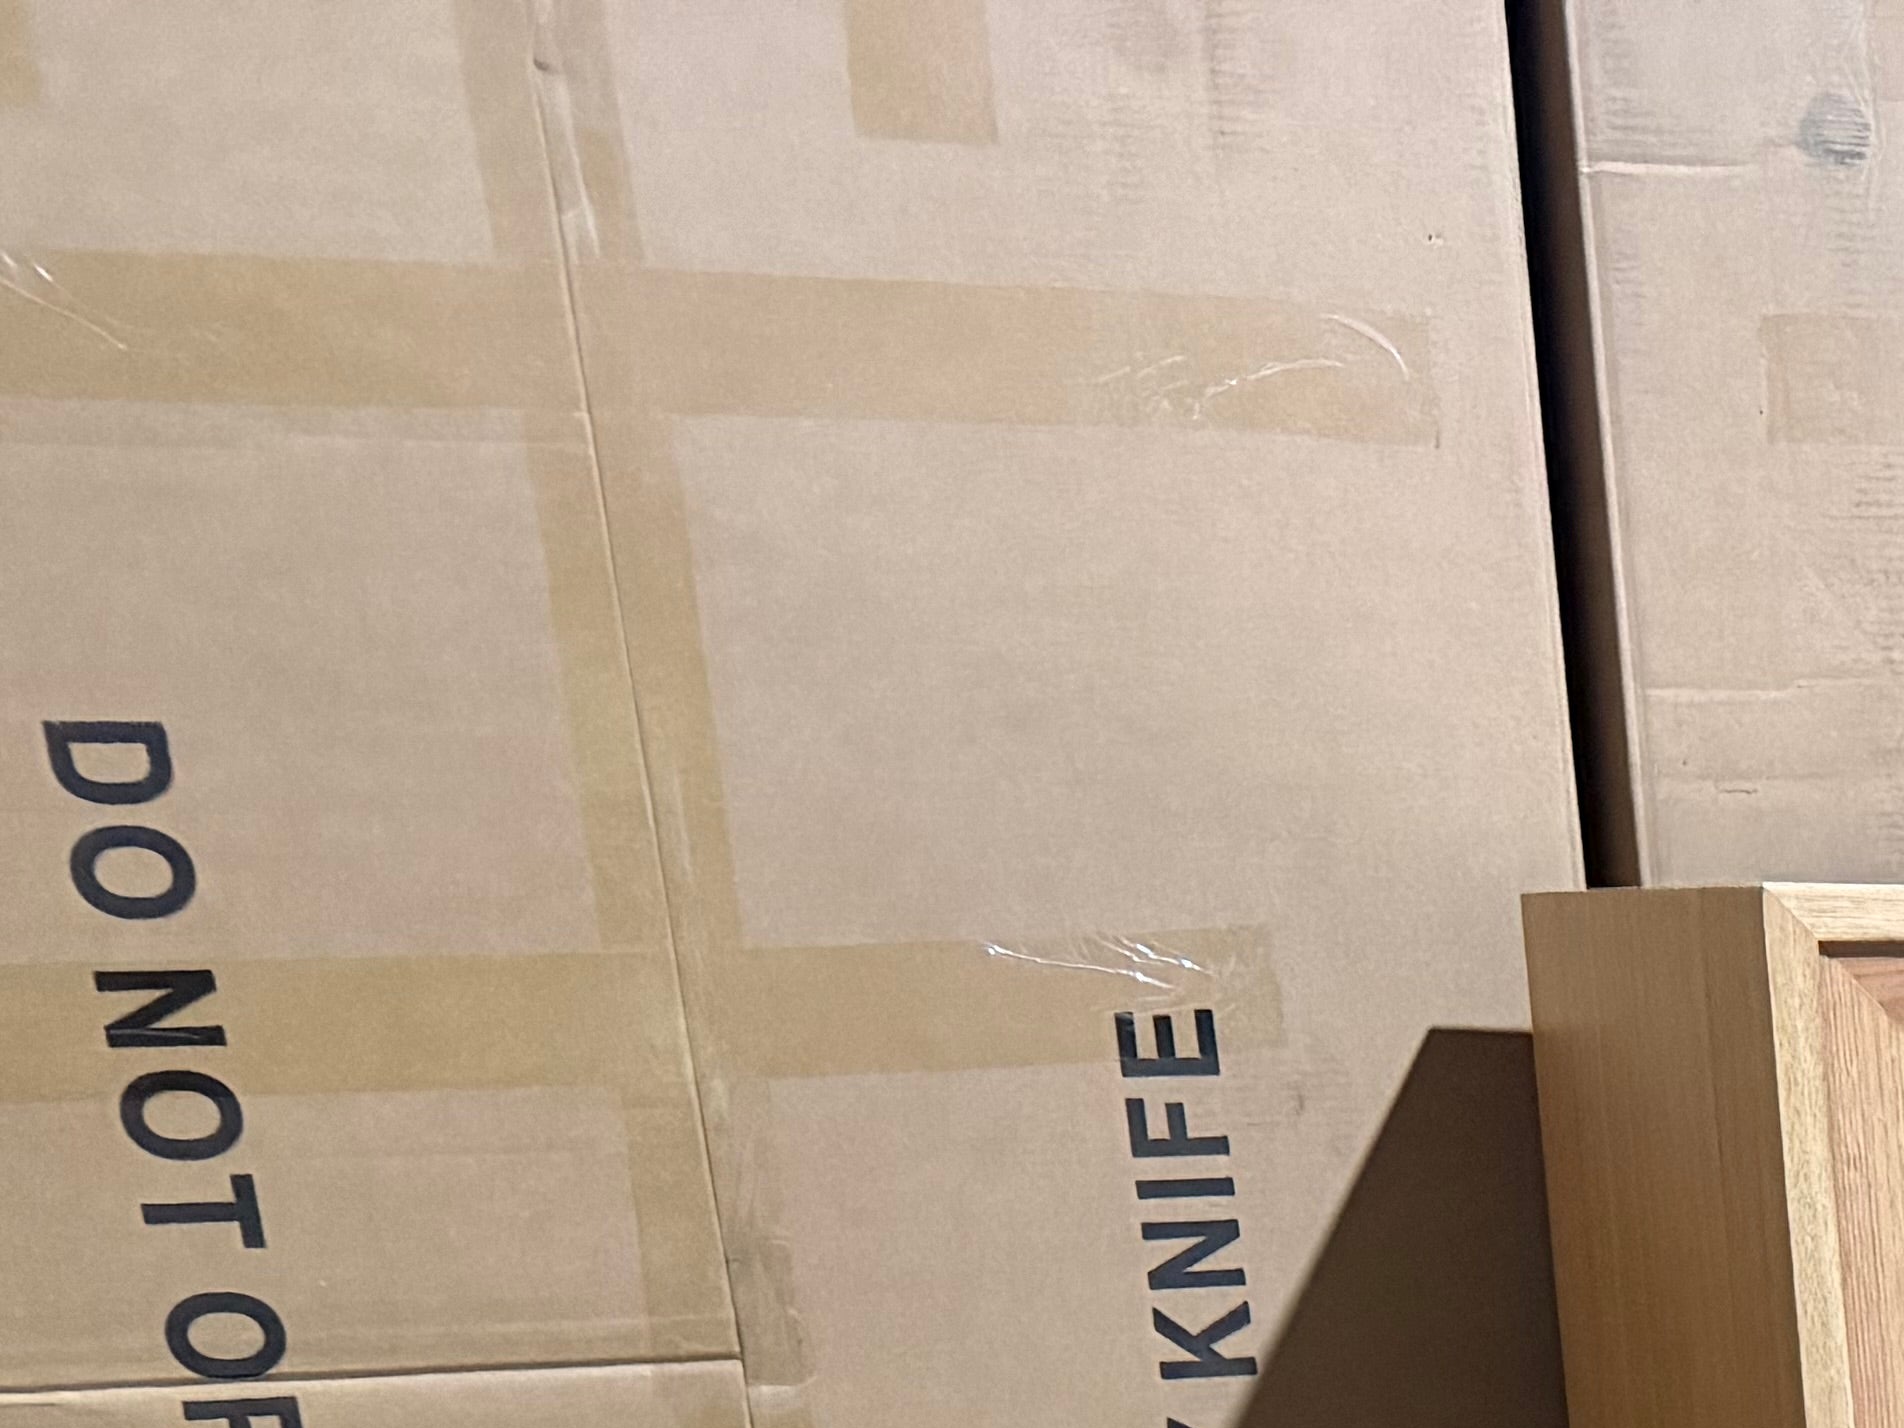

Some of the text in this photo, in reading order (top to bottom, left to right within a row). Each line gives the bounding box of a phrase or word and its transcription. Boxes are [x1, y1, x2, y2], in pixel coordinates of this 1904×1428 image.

[42, 719, 196, 921] DO
[92, 968, 267, 1250] NOT
[1113, 1008, 1259, 1382] KNIFE
